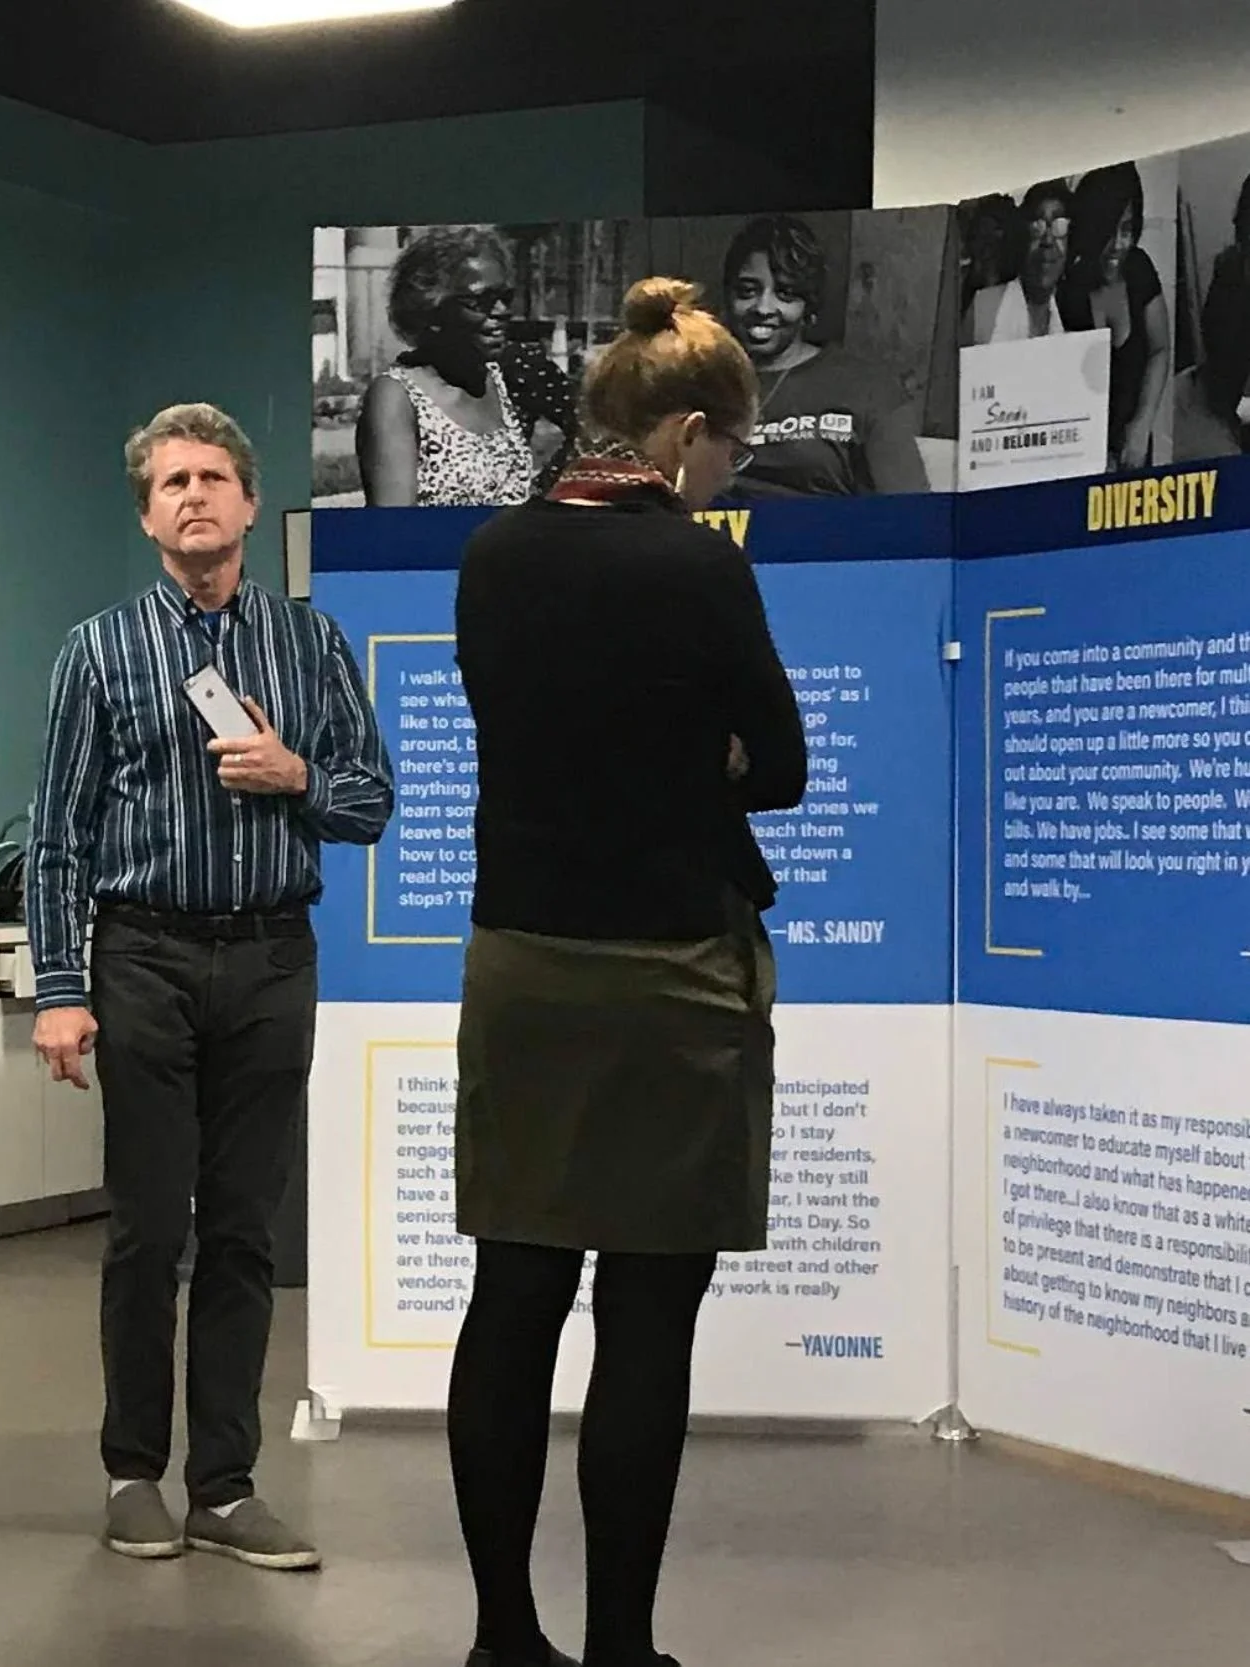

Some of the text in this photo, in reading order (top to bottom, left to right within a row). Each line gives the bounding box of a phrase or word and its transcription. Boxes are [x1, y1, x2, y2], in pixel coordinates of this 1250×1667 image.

[979, 385, 996, 400] AM
[823, 417, 849, 428] UP
[970, 438, 993, 452] AND
[1003, 431, 1048, 450] BELONG
[1087, 469, 1219, 532] DIVERSITY
[400, 670, 448, 685] I walk
[811, 665, 862, 679] out to
[1004, 666, 1217, 698] people that have been there for
[399, 696, 429, 707] see
[399, 736, 462, 752] around,
[830, 732, 857, 747] for,
[399, 781, 471, 798] anything
[806, 777, 847, 792] child
[808, 803, 849, 814] ones
[852, 803, 879, 814] we
[800, 822, 844, 837] them
[1004, 850, 1238, 875] and some that will look you right in
[773, 867, 827, 882] of that
[823, 921, 886, 944] SANDY
[780, 1102, 809, 1116] but
[813, 1102, 818, 1116] I
[822, 1102, 867, 1117] don't
[1003, 1125, 1245, 1169] a newcomer to educate myself about
[792, 1148, 876, 1162] residents,
[396, 1186, 449, 1201] have a
[772, 1237, 881, 1251] with children
[744, 1259, 879, 1274] street and other
[729, 1280, 840, 1300] work is really
[1003, 1265, 1237, 1324] about getting to know my neighbors
